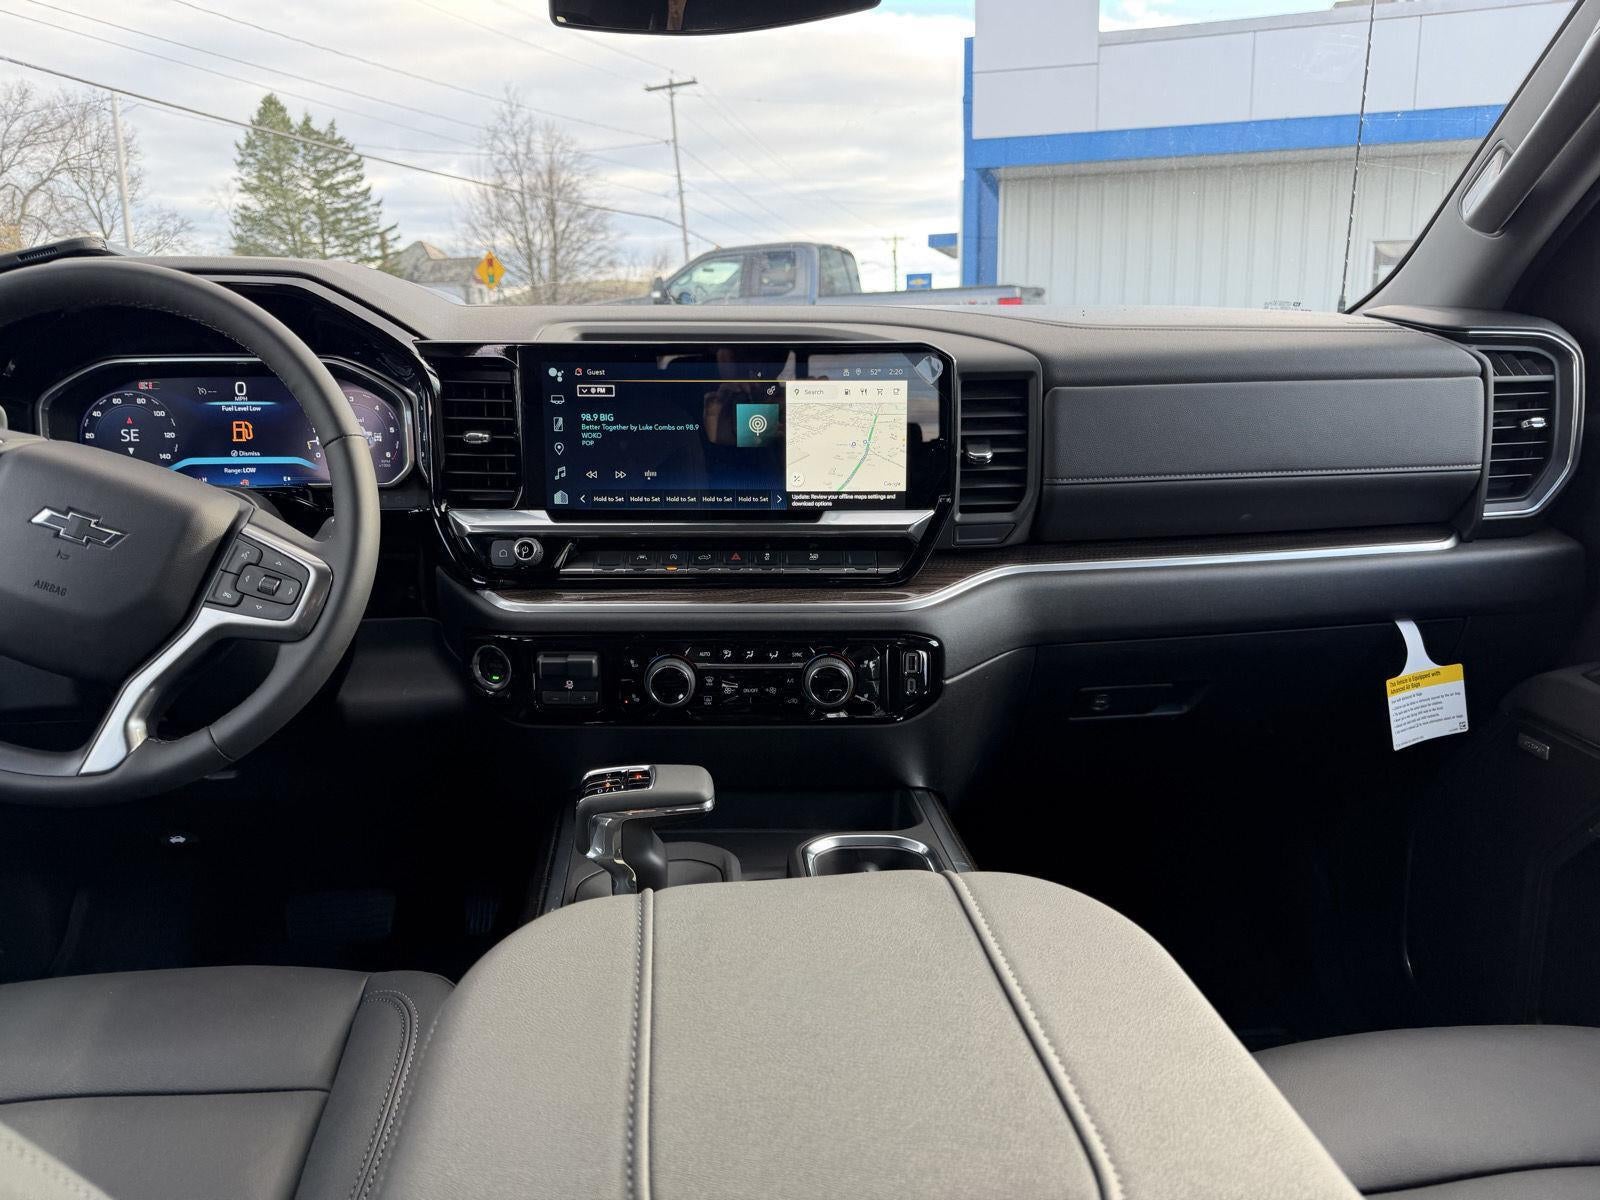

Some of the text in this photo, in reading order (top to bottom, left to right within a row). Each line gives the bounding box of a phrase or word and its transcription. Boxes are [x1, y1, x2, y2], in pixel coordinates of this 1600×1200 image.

[889, 368, 904, 376] 2:20
[235, 381, 247, 396] 0
[580, 413, 614, 422] 98.9 BIG
[602, 424, 629, 432] Together
[630, 424, 638, 432] by
[120, 428, 140, 442] SE
[33, 579, 67, 597] AIRBAG
[1412, 673, 1431, 682] Equipped
